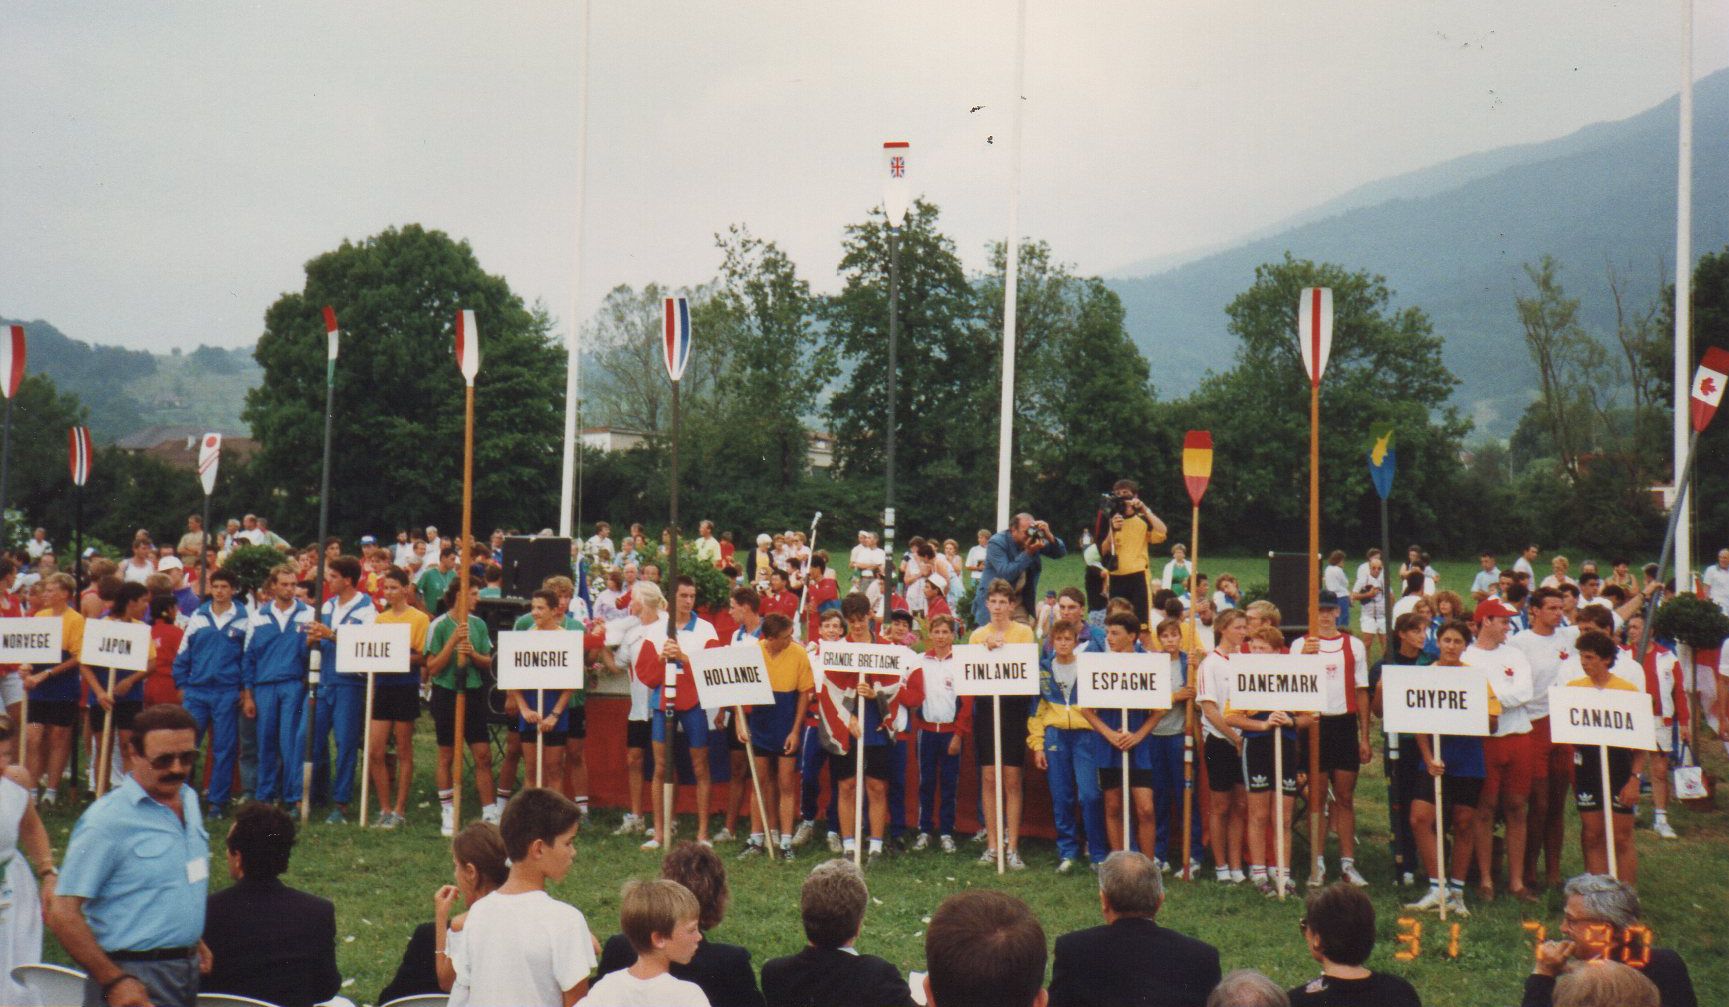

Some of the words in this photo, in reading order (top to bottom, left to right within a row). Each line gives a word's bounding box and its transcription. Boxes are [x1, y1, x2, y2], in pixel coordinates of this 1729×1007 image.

[2, 633, 51, 649] NORVEGE
[98, 637, 132, 655] JAPON
[355, 642, 390, 658] ITALIE
[514, 650, 568, 668] HONGRIE
[823, 651, 854, 667] GRANDE
[858, 653, 901, 671] BRETAGNE
[703, 665, 762, 686] HOLLANDE
[964, 662, 1027, 680] FINLANDE
[1092, 672, 1157, 691] ESPAGNE
[1237, 673, 1318, 693] DANEMARK
[1406, 689, 1468, 710] CHYPRE
[1570, 707, 1634, 731] CANADA
